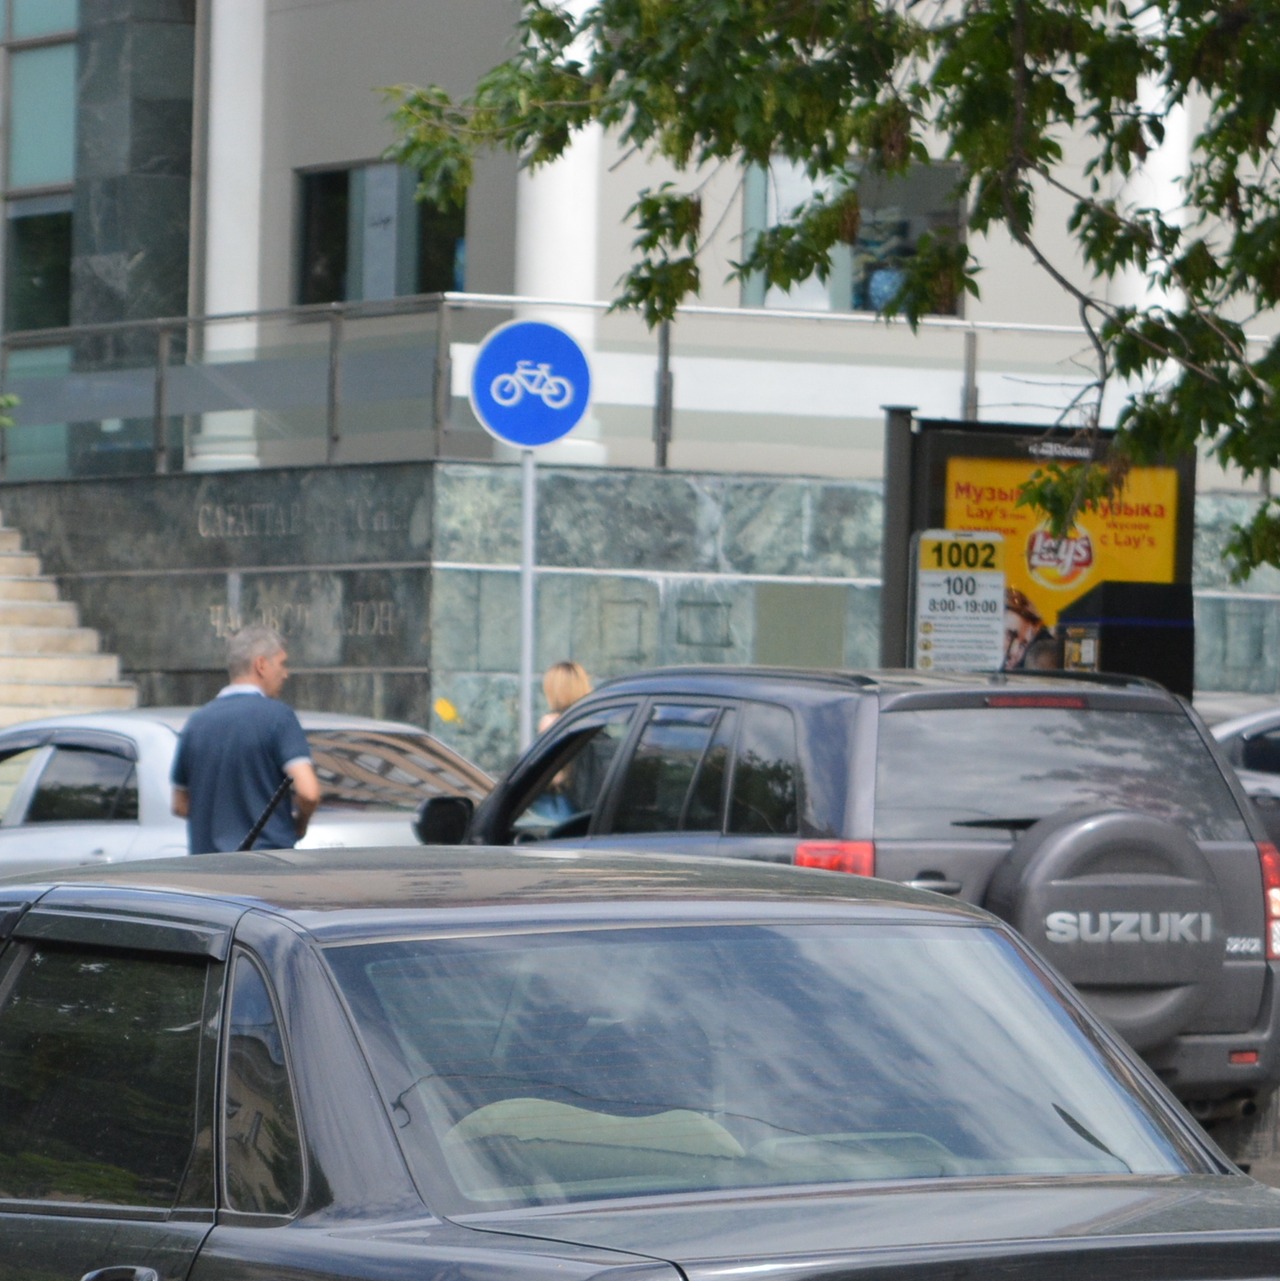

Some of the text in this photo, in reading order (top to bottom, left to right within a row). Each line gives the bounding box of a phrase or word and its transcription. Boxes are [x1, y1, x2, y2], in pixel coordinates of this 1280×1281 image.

[954, 482, 1024, 504] Музы
[1084, 498, 1166, 519] узыка
[931, 542, 996, 569] 1002
[943, 576, 976, 596] 100
[1045, 911, 1212, 943] SUZUKI
